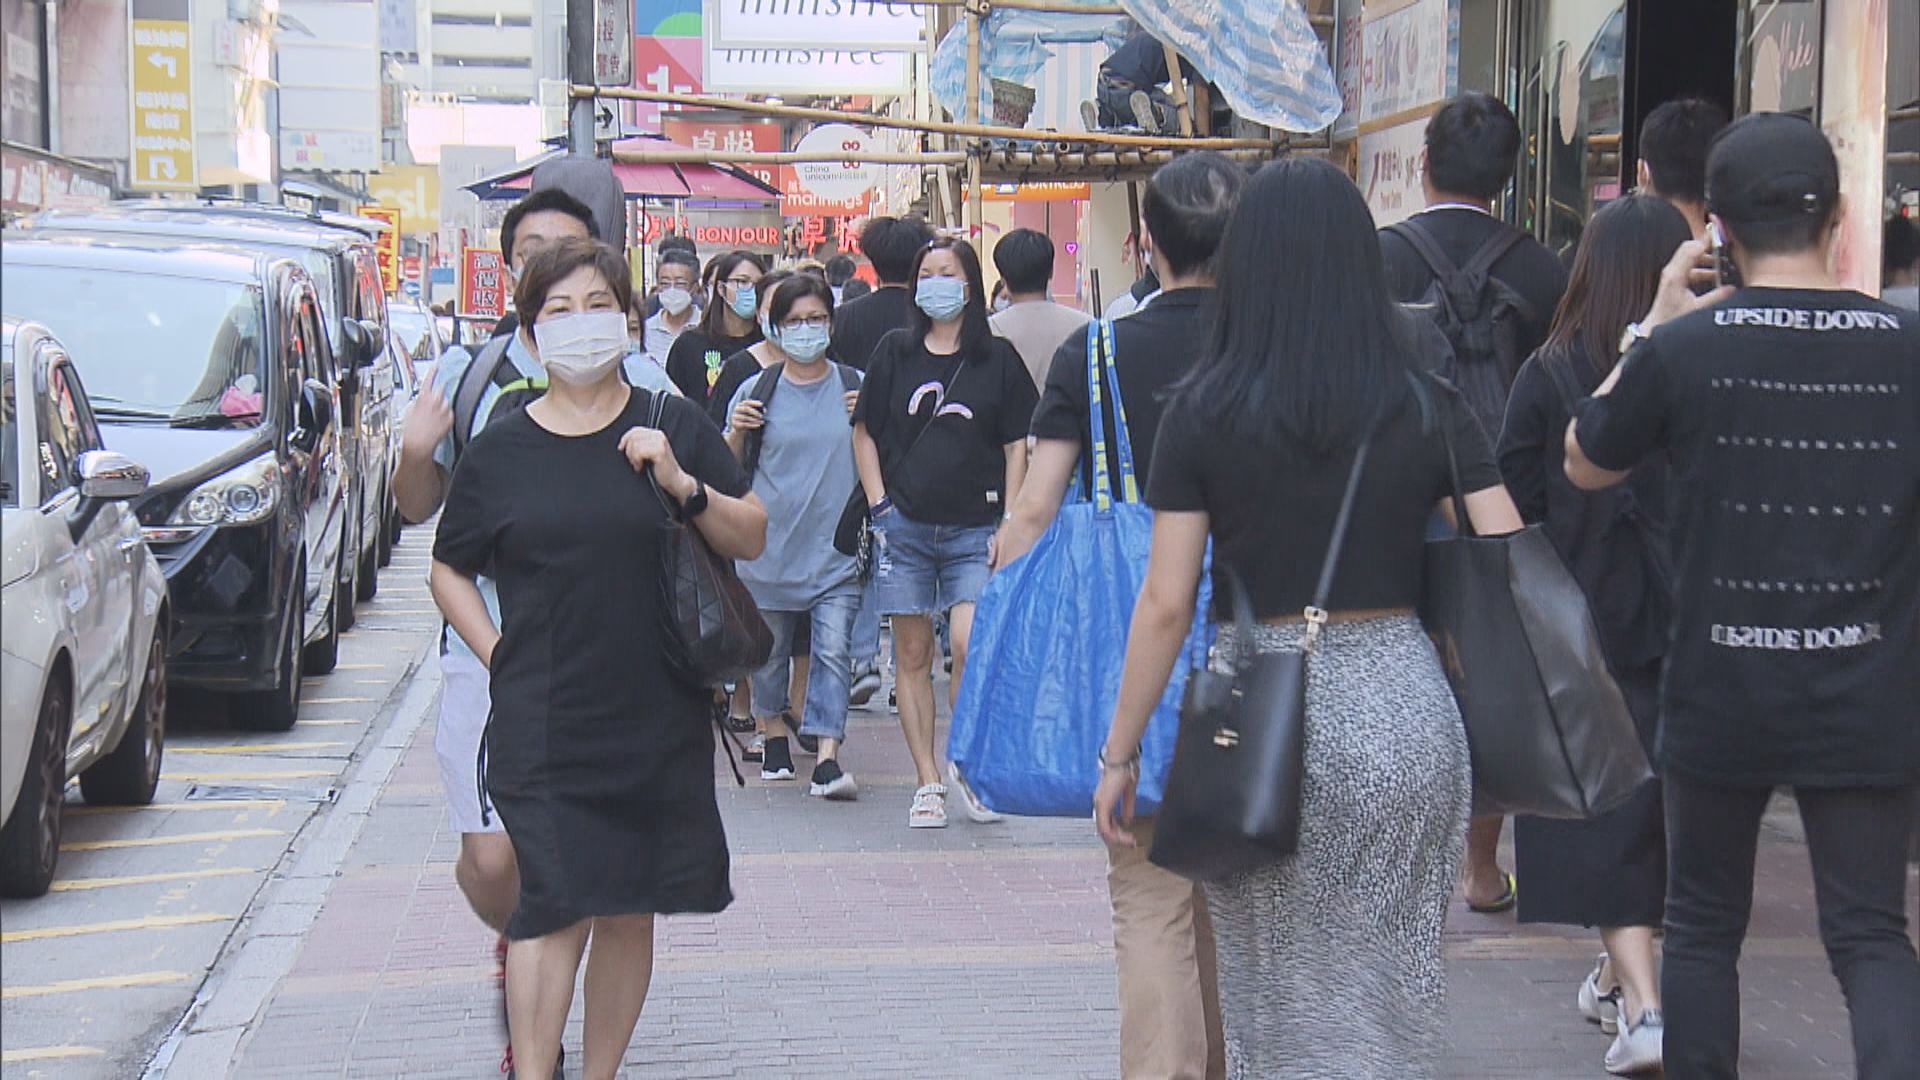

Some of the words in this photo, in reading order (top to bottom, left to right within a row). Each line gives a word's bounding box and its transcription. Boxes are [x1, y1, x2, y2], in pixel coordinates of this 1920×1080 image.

[695, 226, 779, 246] BONJOUR
[1714, 307, 1810, 330] UPSIDE
[1813, 310, 1900, 331] DOWN
